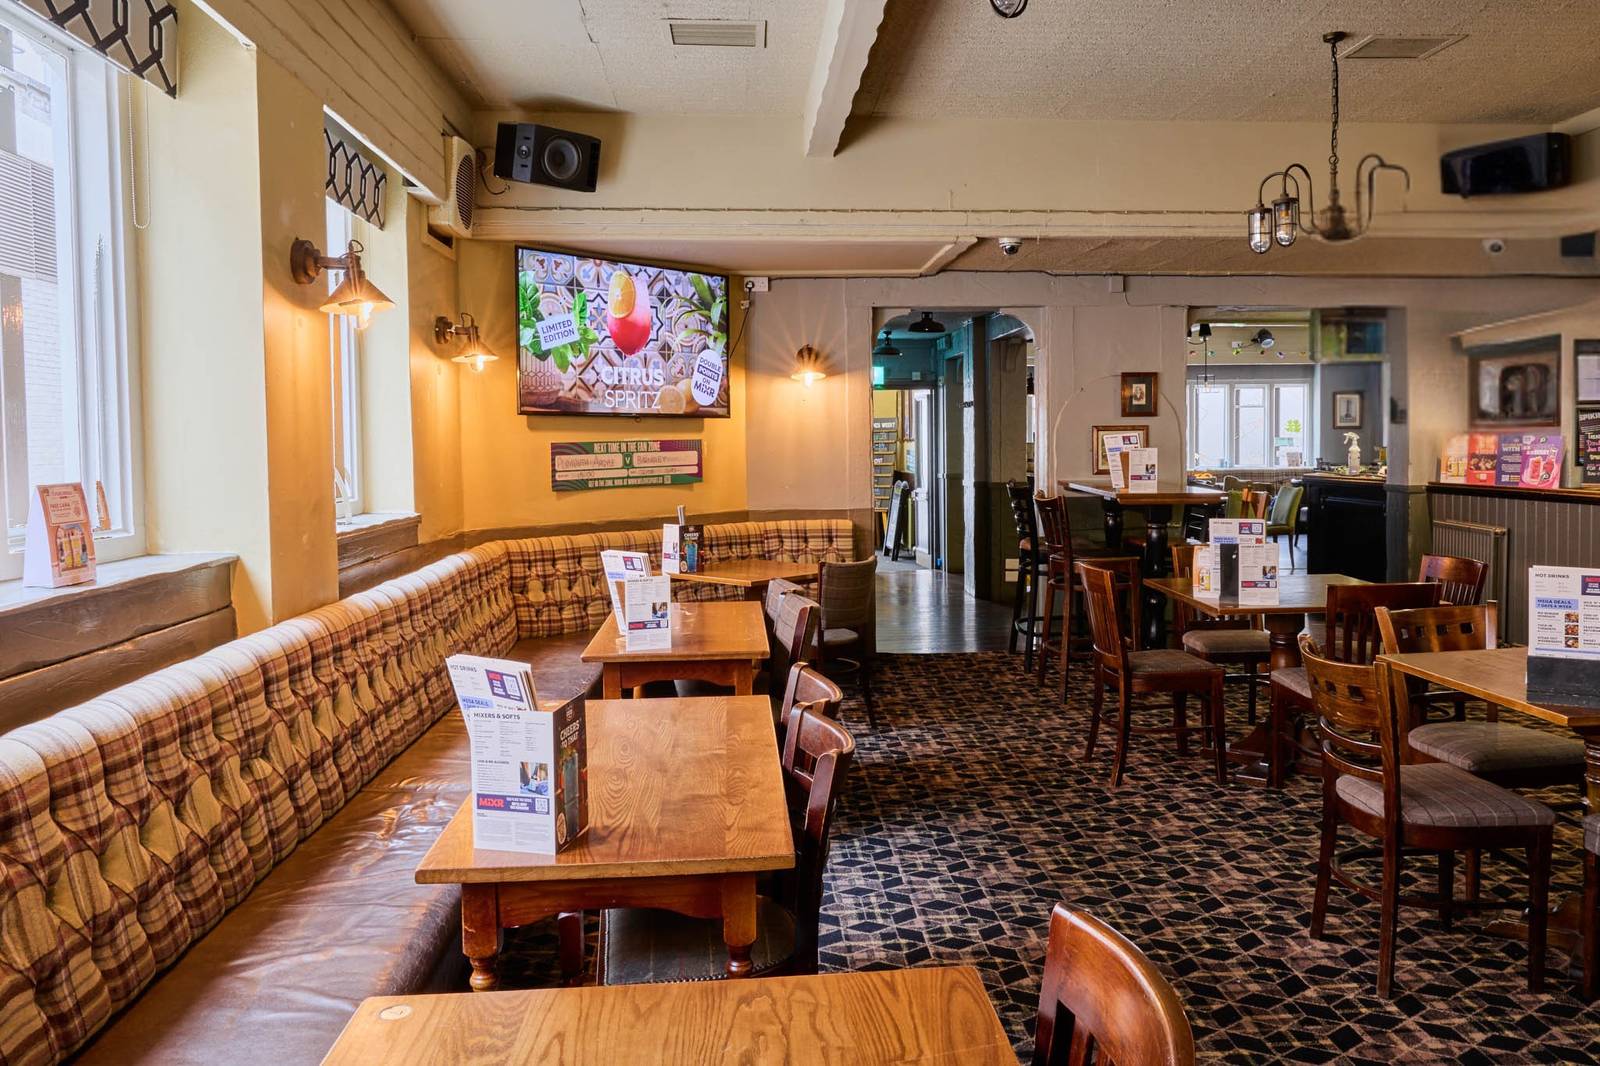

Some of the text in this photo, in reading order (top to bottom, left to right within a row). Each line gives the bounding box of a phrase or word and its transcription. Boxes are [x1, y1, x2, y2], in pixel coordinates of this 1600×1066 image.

[541, 319, 573, 334] LIMITED
[544, 329, 575, 344] EDITION
[700, 357, 721, 372] DOUBLE
[601, 366, 665, 386] CITRUS
[604, 390, 661, 409] SPRITZ
[594, 442, 607, 454] NEXT
[608, 442, 620, 453] TIME
[621, 442, 627, 453] IN
[628, 442, 637, 453] THE
[648, 441, 661, 452] ZONE
[560, 720, 580, 740] CHEERS
[561, 731, 580, 748] TO THAT
